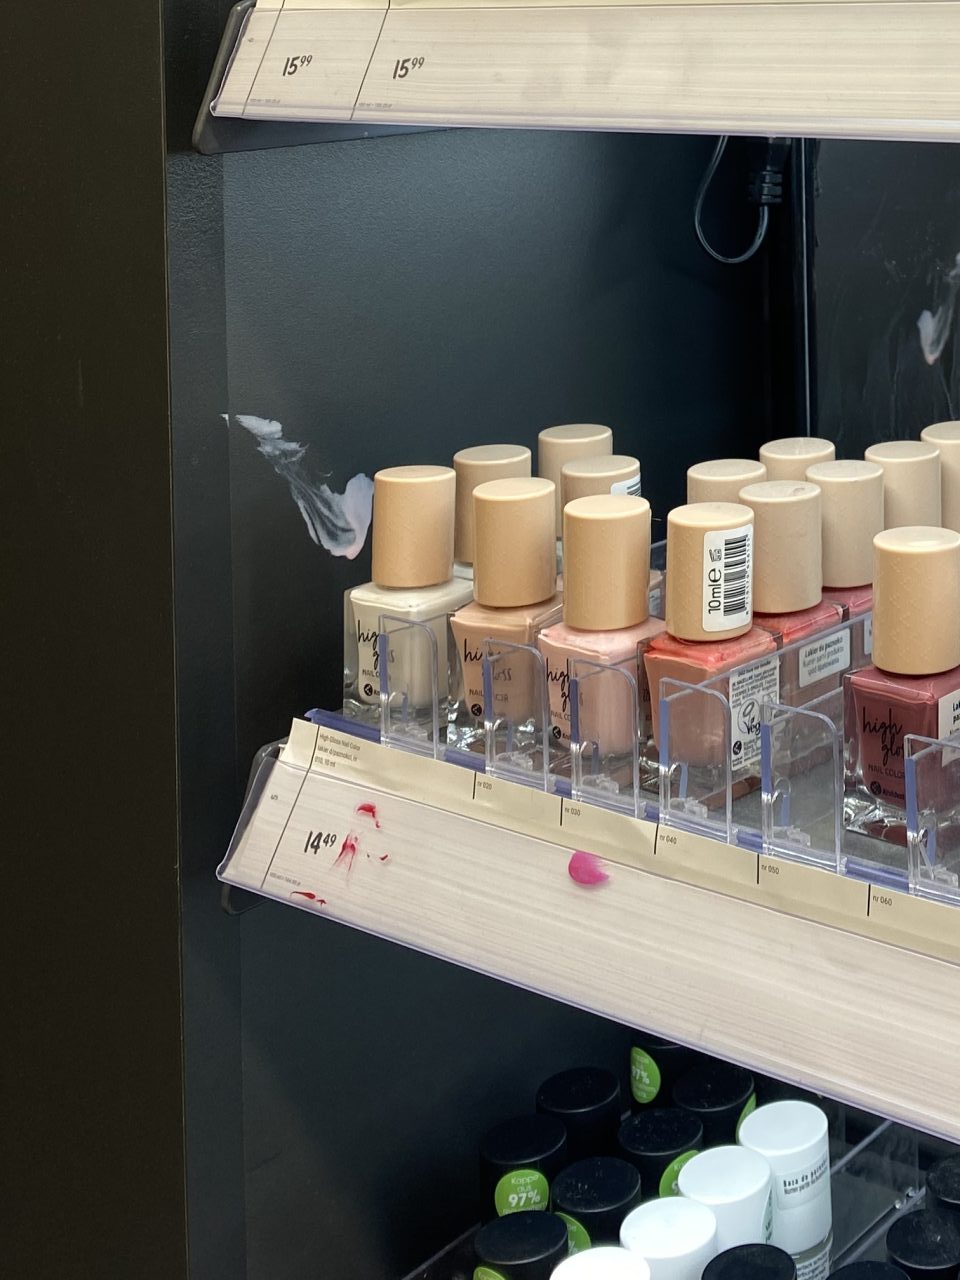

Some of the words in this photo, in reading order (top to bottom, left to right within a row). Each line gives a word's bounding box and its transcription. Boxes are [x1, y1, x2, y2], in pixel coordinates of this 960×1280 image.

[282, 54, 313, 77] 1599
[392, 56, 425, 80] 1599
[862, 706, 903, 741] high
[867, 764, 884, 776] NAIL
[303, 830, 337, 856] 1449
[659, 833, 666, 841] nr
[666, 835, 678, 845] 040
[761, 863, 768, 871] nr
[768, 865, 780, 875] 050
[872, 894, 880, 902] nr
[880, 896, 893, 906] 060
[508, 1188, 541, 1208] 97%
